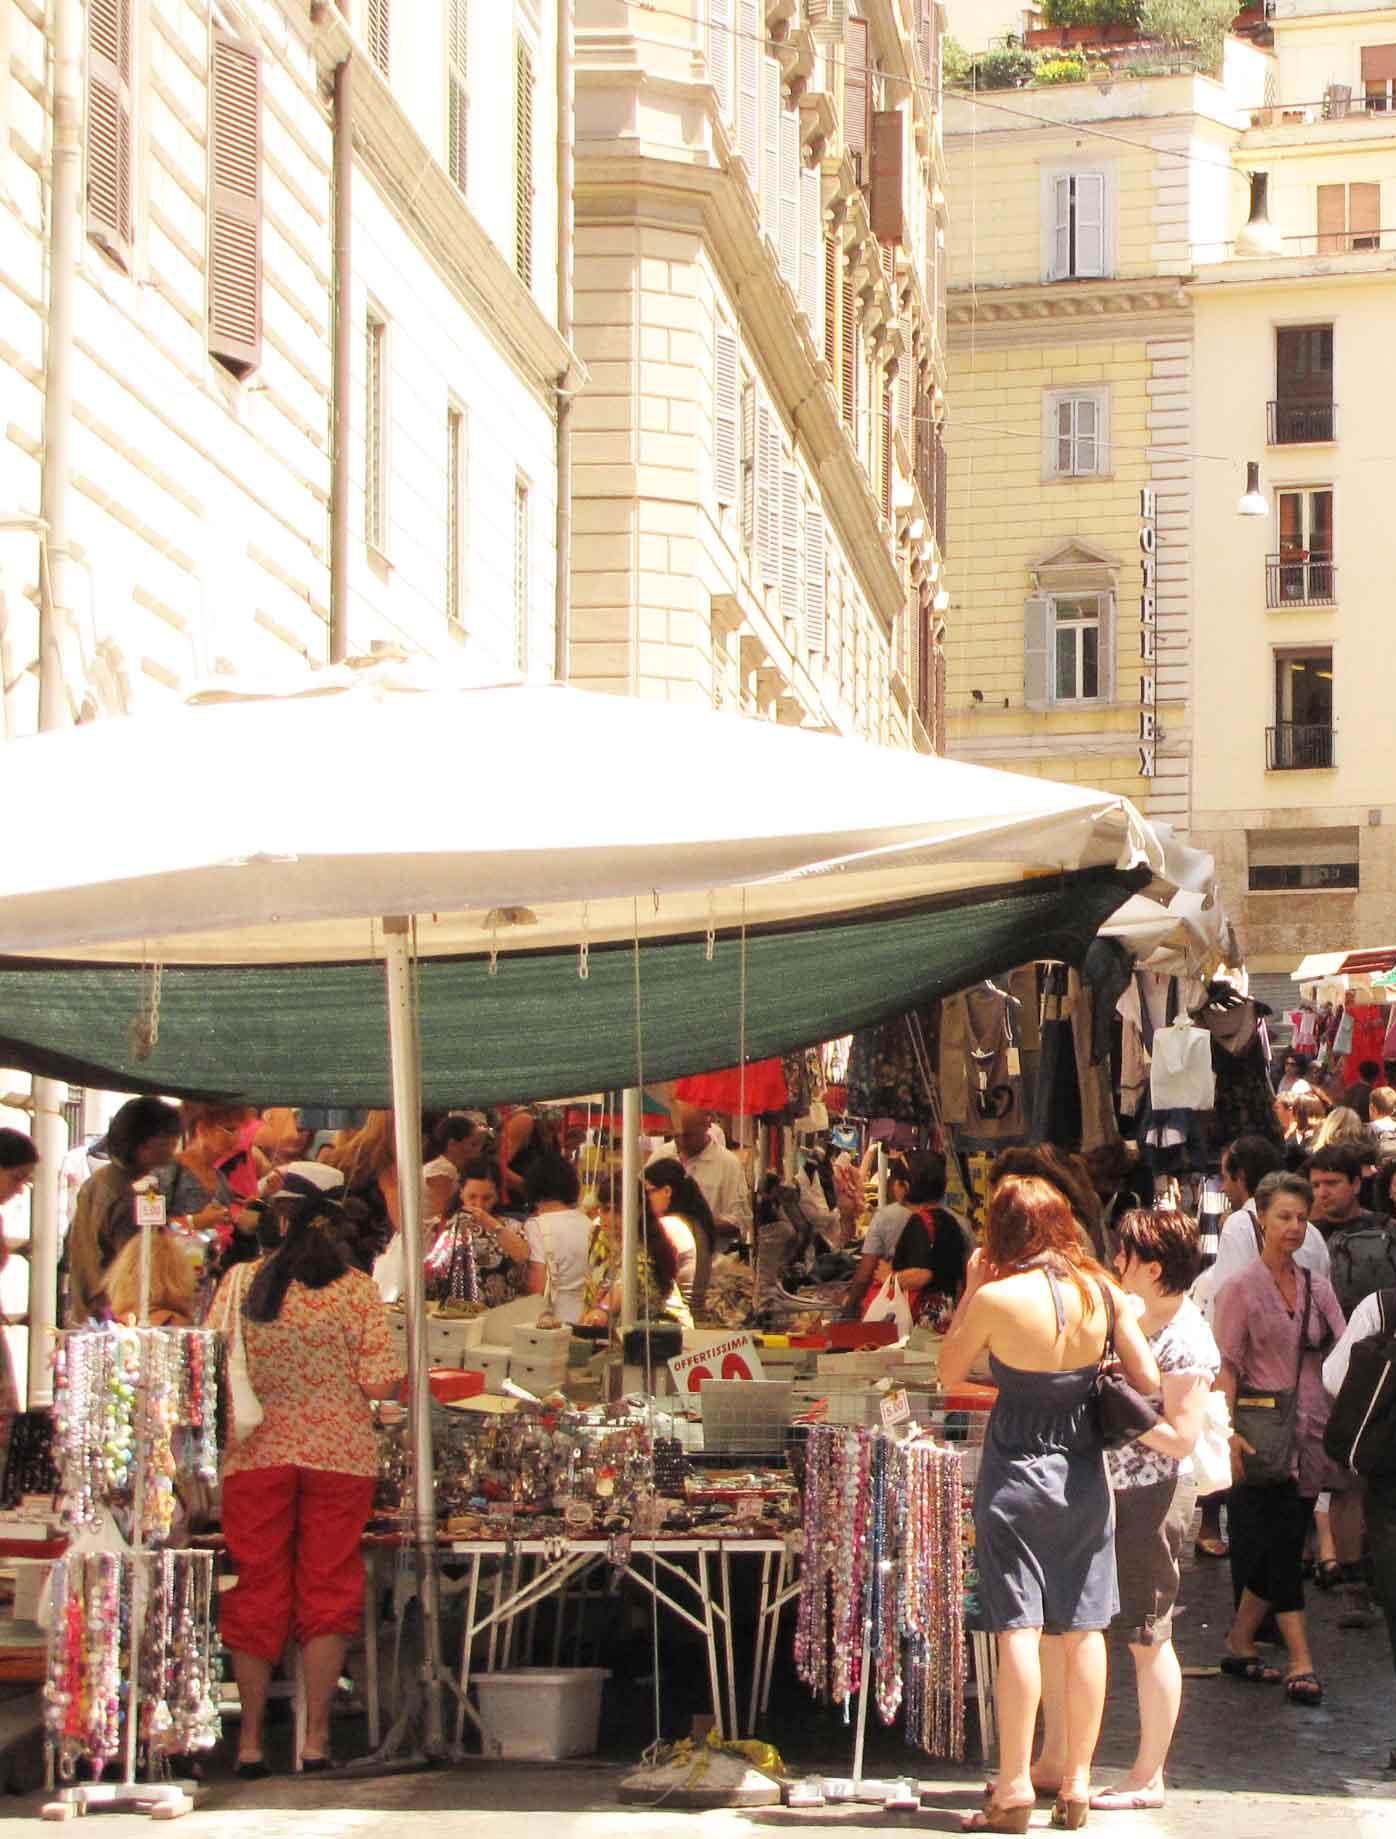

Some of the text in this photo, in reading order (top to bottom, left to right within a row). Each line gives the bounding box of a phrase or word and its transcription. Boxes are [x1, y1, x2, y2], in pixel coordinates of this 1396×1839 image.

[1139, 488, 1155, 776] HOTEL REX
[673, 1335, 749, 1373] OFFERTISSIMA
